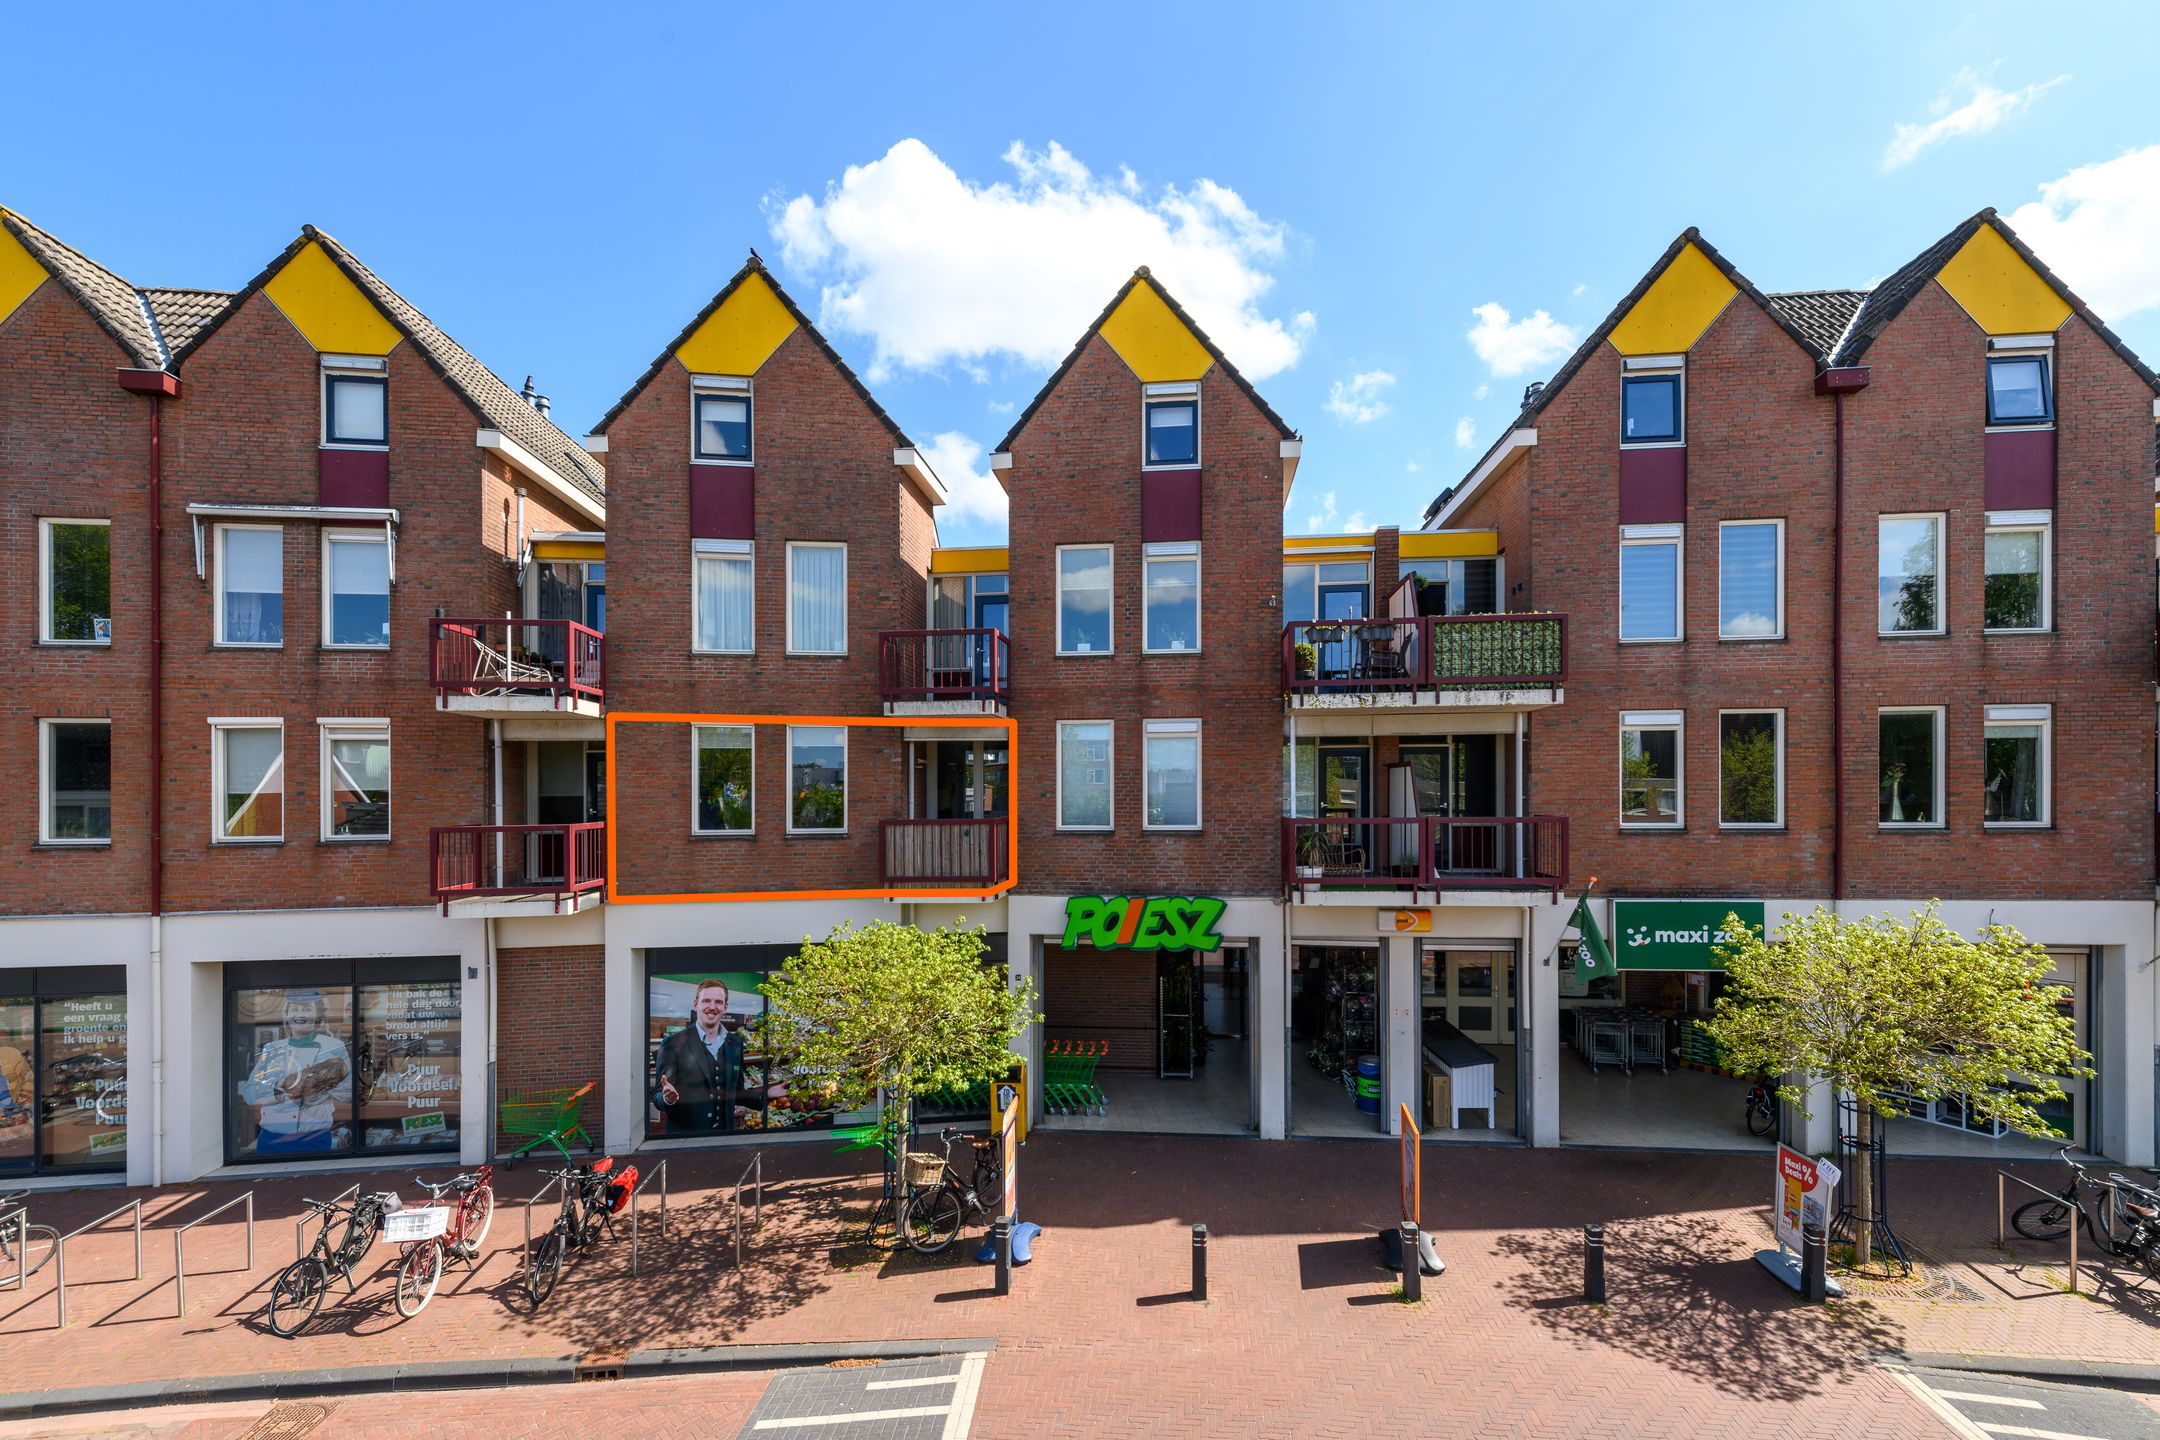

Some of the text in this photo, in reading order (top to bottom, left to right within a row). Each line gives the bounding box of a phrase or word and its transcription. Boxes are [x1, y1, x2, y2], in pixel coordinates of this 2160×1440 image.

[1061, 896, 1228, 952] POIESZ
[1655, 925, 1739, 943] maxi zo
[406, 990, 426, 998] bak
[429, 989, 442, 998] de
[386, 1001, 408, 1009] hele
[412, 1000, 432, 1010] dag
[63, 1015, 85, 1023] een
[88, 1014, 121, 1022] vraag
[385, 1011, 415, 1019] zodat
[63, 1024, 108, 1035] groente
[385, 1019, 448, 1030] brood altijd
[79, 1034, 104, 1044] help
[105, 1035, 115, 1043] u
[385, 1032, 408, 1040] vers
[408, 1064, 440, 1076] Puur
[75, 1095, 127, 1110] Voorde
[408, 1096, 440, 1109] Puur
